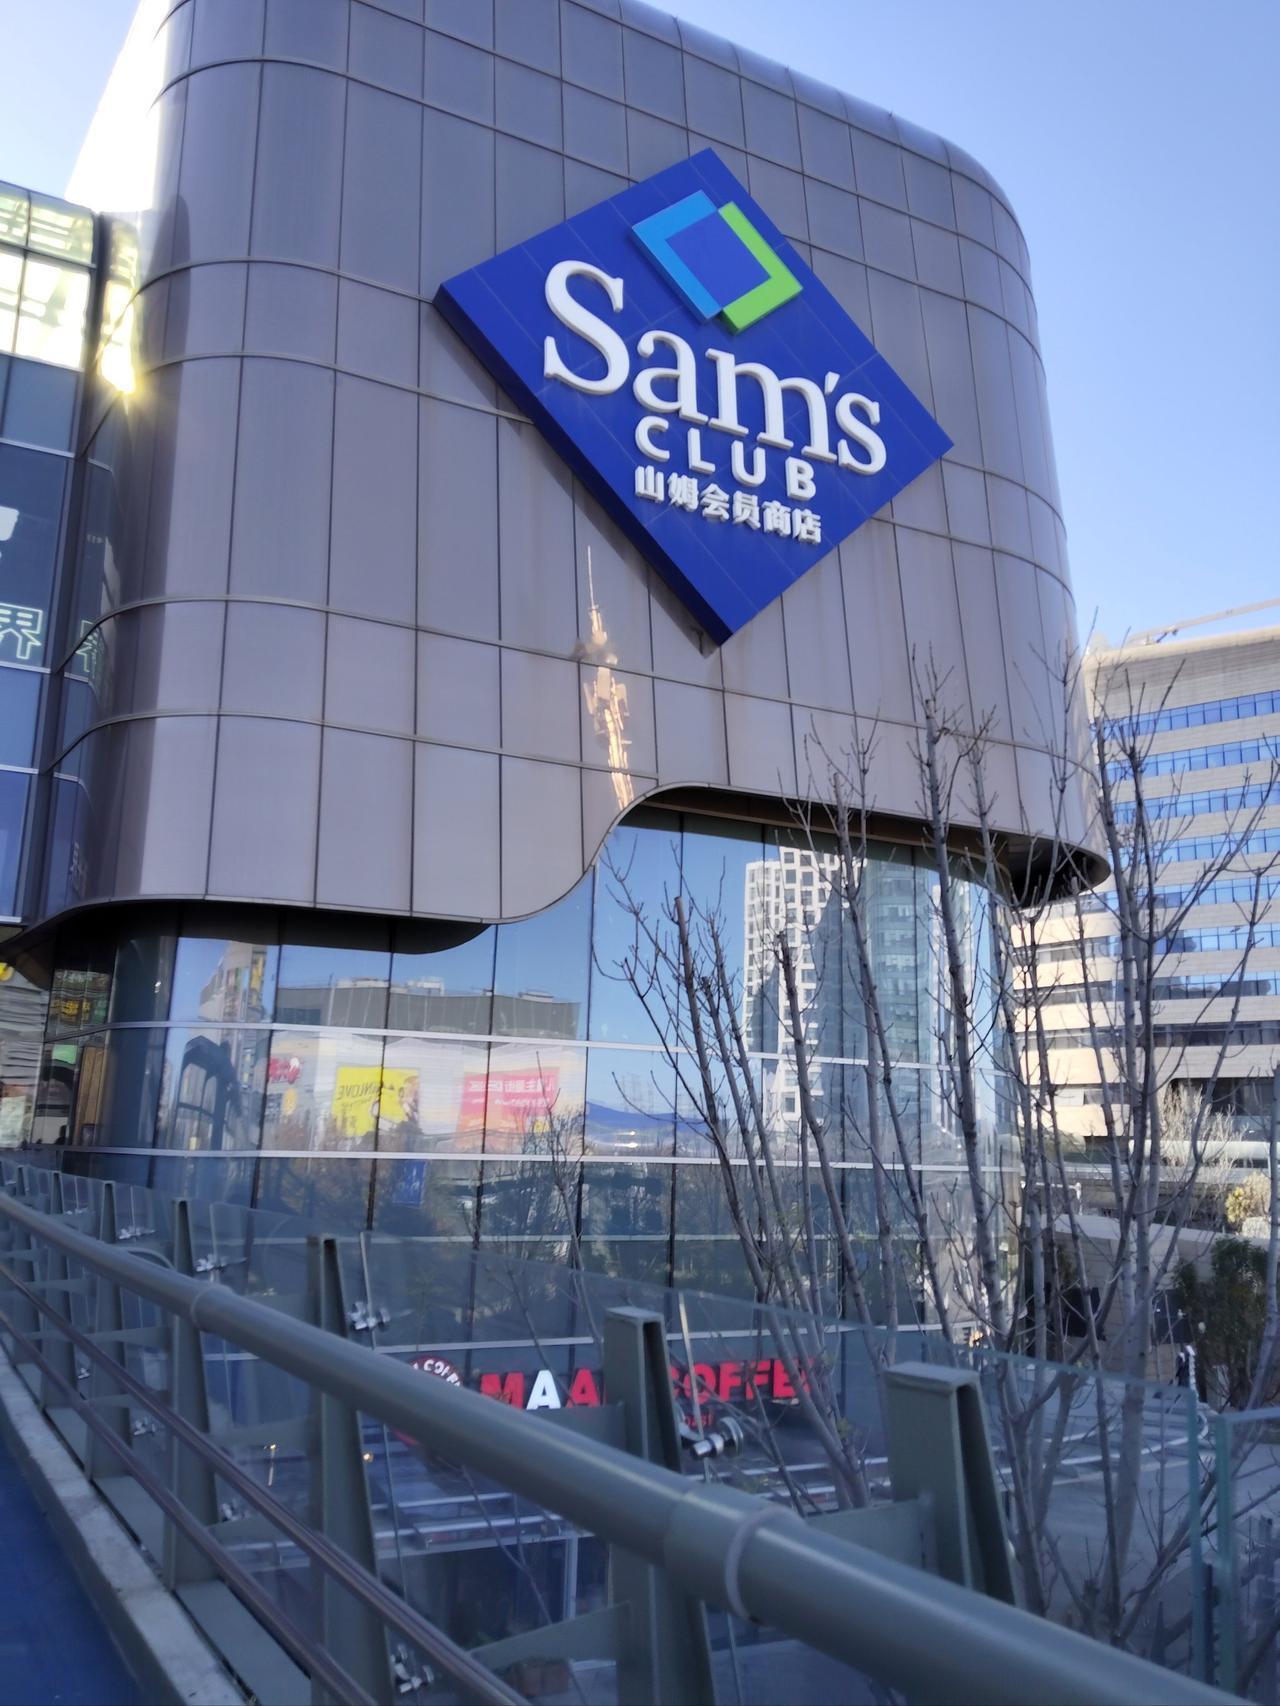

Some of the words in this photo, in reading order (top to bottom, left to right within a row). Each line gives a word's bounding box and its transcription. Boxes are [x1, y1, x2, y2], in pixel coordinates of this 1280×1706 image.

[544, 260, 887, 475] Sam's
[635, 416, 816, 500] CLUB
[634, 465, 821, 545] 山姆会员商店
